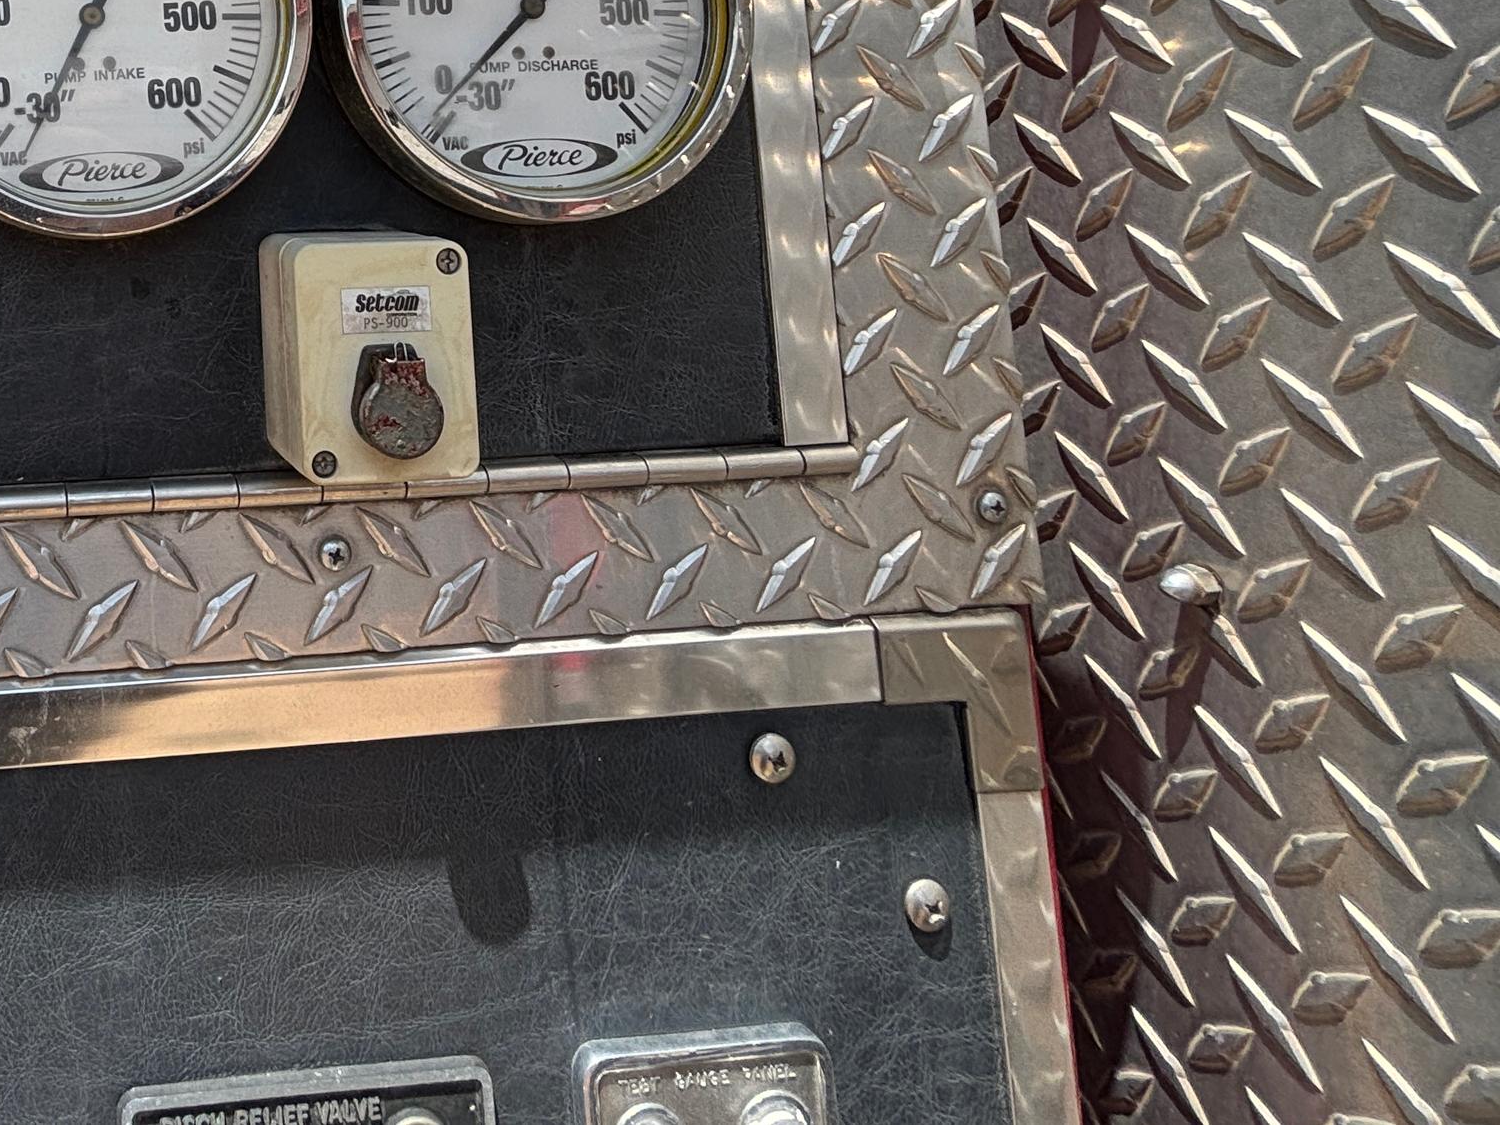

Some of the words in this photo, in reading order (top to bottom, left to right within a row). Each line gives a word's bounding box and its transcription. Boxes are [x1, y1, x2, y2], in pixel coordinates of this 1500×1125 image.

[163, 0, 217, 32] 500
[94, 67, 146, 81] INTAKE
[518, 59, 599, 72] DISCHARGE
[434, 64, 453, 95] 0
[584, 70, 635, 101] 600
[147, 77, 202, 110] 600
[183, 138, 205, 159] psi
[442, 136, 469, 151] VAC
[616, 129, 636, 148] psi
[0, 150, 27, 166] VAC
[498, 144, 583, 170] Pierce
[58, 158, 148, 187] Pierce
[363, 317, 408, 329] PS-900
[315, 1096, 381, 1125] VALVE
